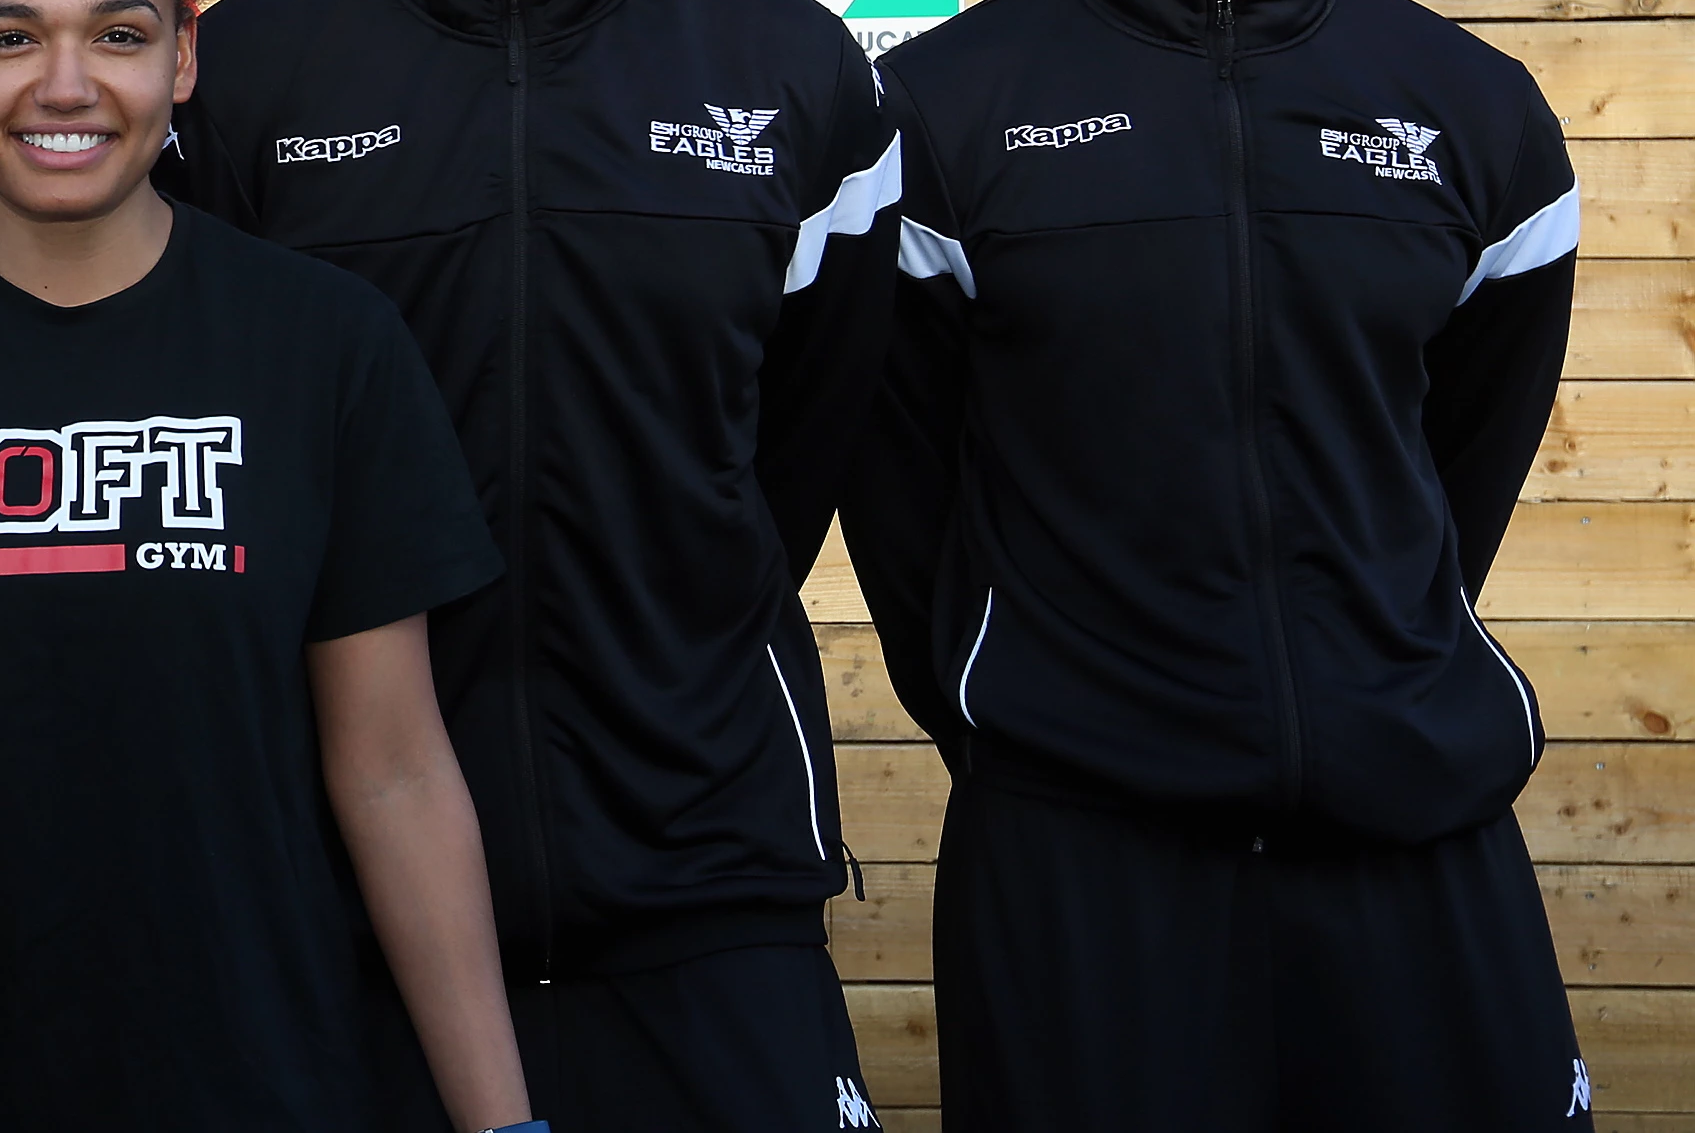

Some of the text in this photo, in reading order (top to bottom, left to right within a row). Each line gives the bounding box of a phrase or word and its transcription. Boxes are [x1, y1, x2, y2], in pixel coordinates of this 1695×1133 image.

[275, 124, 402, 164] Kappa
[650, 120, 724, 144] ESH GROUP
[1004, 112, 1132, 151] Kappa
[1320, 128, 1401, 151] ESH GROUP
[648, 133, 775, 165] EAGLES
[705, 158, 774, 176] NEWCASTLE
[135, 541, 227, 571] GYM
